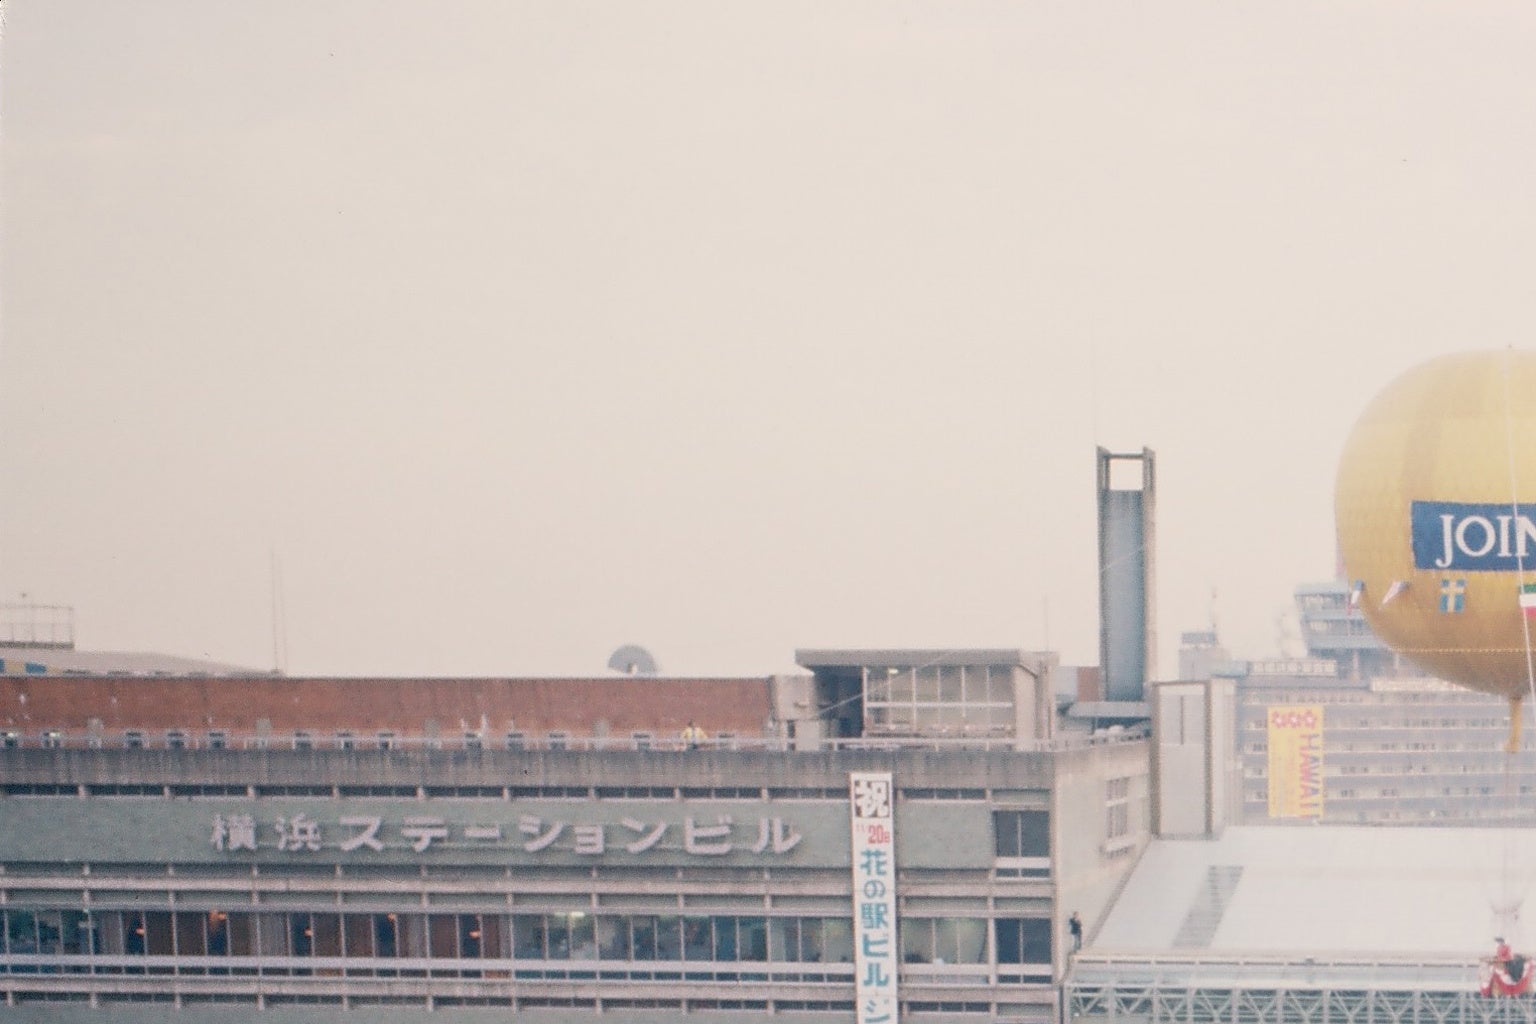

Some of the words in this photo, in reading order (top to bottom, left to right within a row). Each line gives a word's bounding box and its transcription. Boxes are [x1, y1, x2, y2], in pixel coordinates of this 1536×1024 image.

[210, 812, 802, 855] 横浜ステーションビル
